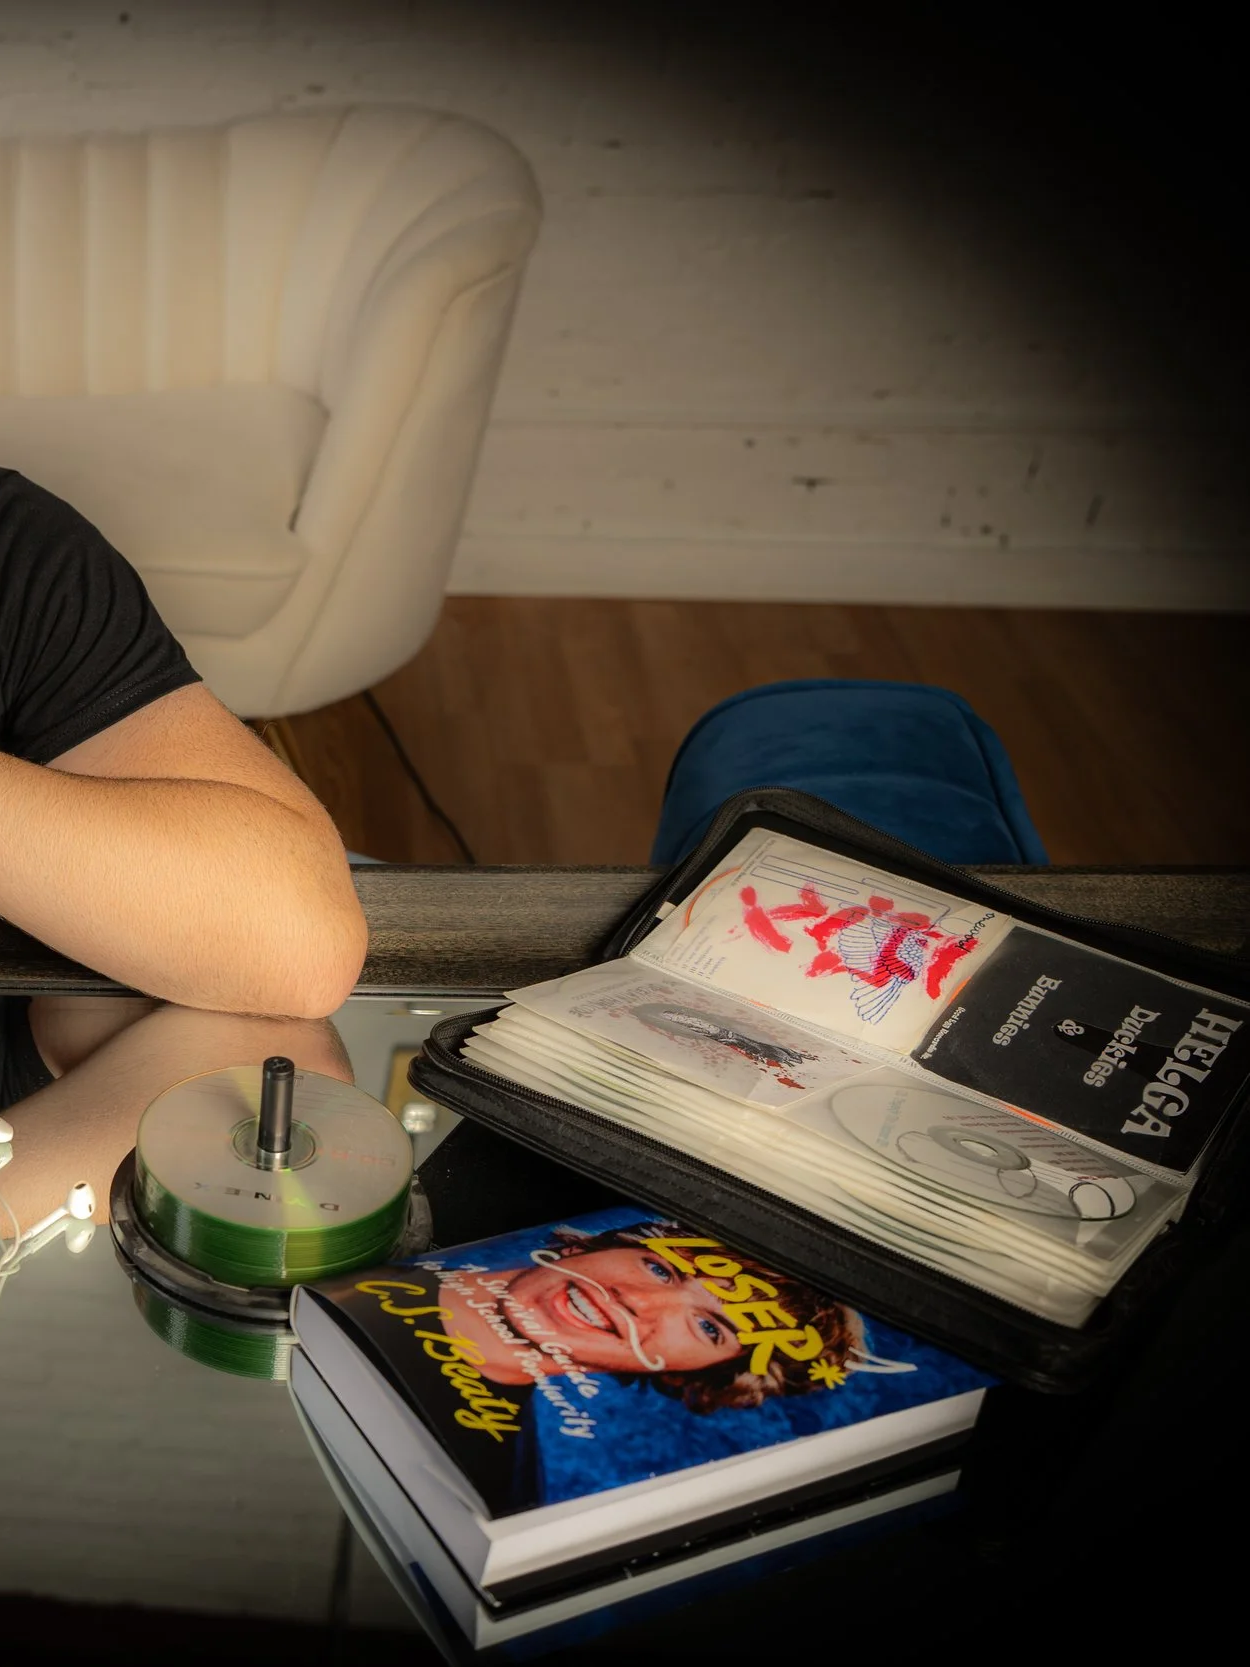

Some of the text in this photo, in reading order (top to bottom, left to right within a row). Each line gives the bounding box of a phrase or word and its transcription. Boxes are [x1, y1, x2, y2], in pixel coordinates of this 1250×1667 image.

[992, 974, 1063, 1047] Bunnies
[1057, 1018, 1085, 1037] &
[1083, 1004, 1162, 1088] Duckies
[1120, 1007, 1244, 1138] HELGA
[414, 1260, 598, 1440] to High School Popularity
[414, 1329, 522, 1443] Beaty
[459, 1263, 601, 1399] A Survival Guide
